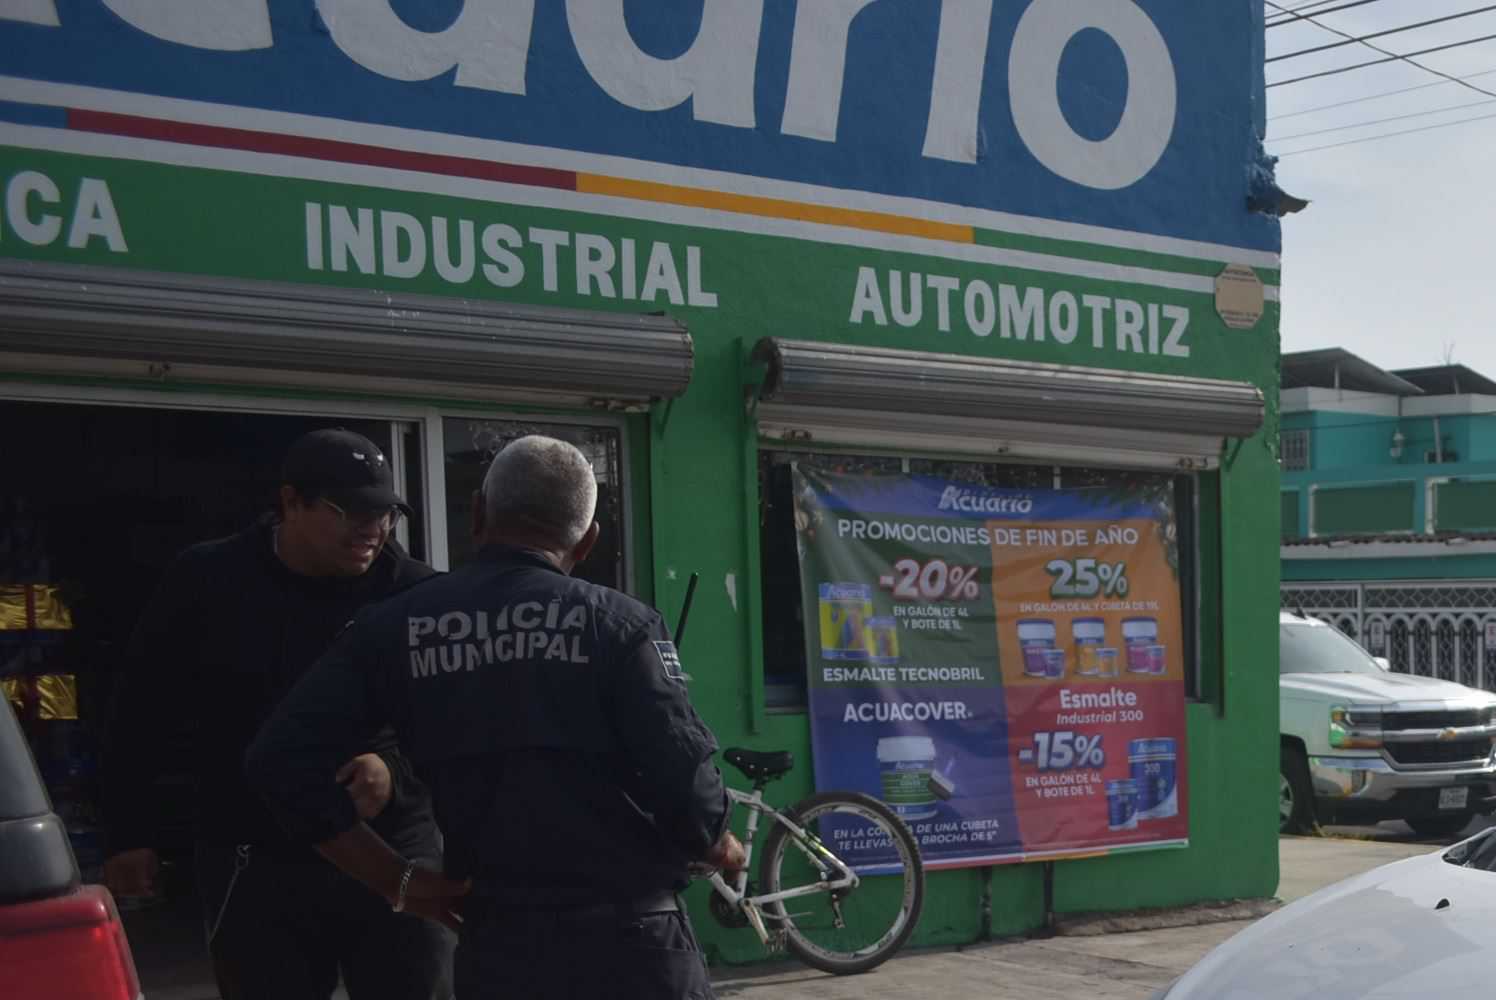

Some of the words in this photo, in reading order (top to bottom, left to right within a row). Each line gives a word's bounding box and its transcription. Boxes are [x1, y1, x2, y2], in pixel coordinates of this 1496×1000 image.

[0, 170, 129, 252] CA
[304, 201, 719, 308] INDUSTRIAL
[848, 265, 1190, 358] AUTOMOTRIZ
[938, 485, 1033, 513] Acuario
[837, 518, 992, 545] PROMOCIONES
[994, 528, 1022, 545] DE
[1026, 529, 1057, 546] FIN
[1061, 529, 1089, 546] DE
[1094, 525, 1139, 546] AÑO
[879, 557, 980, 598] -20%
[1046, 557, 1129, 597] 25%
[893, 605, 906, 617] EN
[943, 605, 955, 617] DE
[903, 618, 910, 630] Y
[938, 619, 951, 630] DE
[822, 667, 897, 682] ESMALTE
[898, 666, 985, 681] TECNOBRIL
[1059, 687, 1137, 709] Esmalte
[1056, 710, 1117, 725] Industrial
[1119, 709, 1144, 722] 300
[1018, 731, 1105, 769] -15%
[1025, 776, 1039, 787] EN
[1075, 773, 1089, 784] DE
[1036, 788, 1043, 798] Y
[1070, 786, 1083, 797] DE
[834, 829, 848, 840] EN
[851, 827, 866, 839] LA
[916, 822, 932, 834] DE
[934, 822, 959, 833] UNA
[960, 818, 1000, 831] CUBETA
[970, 831, 984, 843] DE
[839, 839, 852, 851] TE
